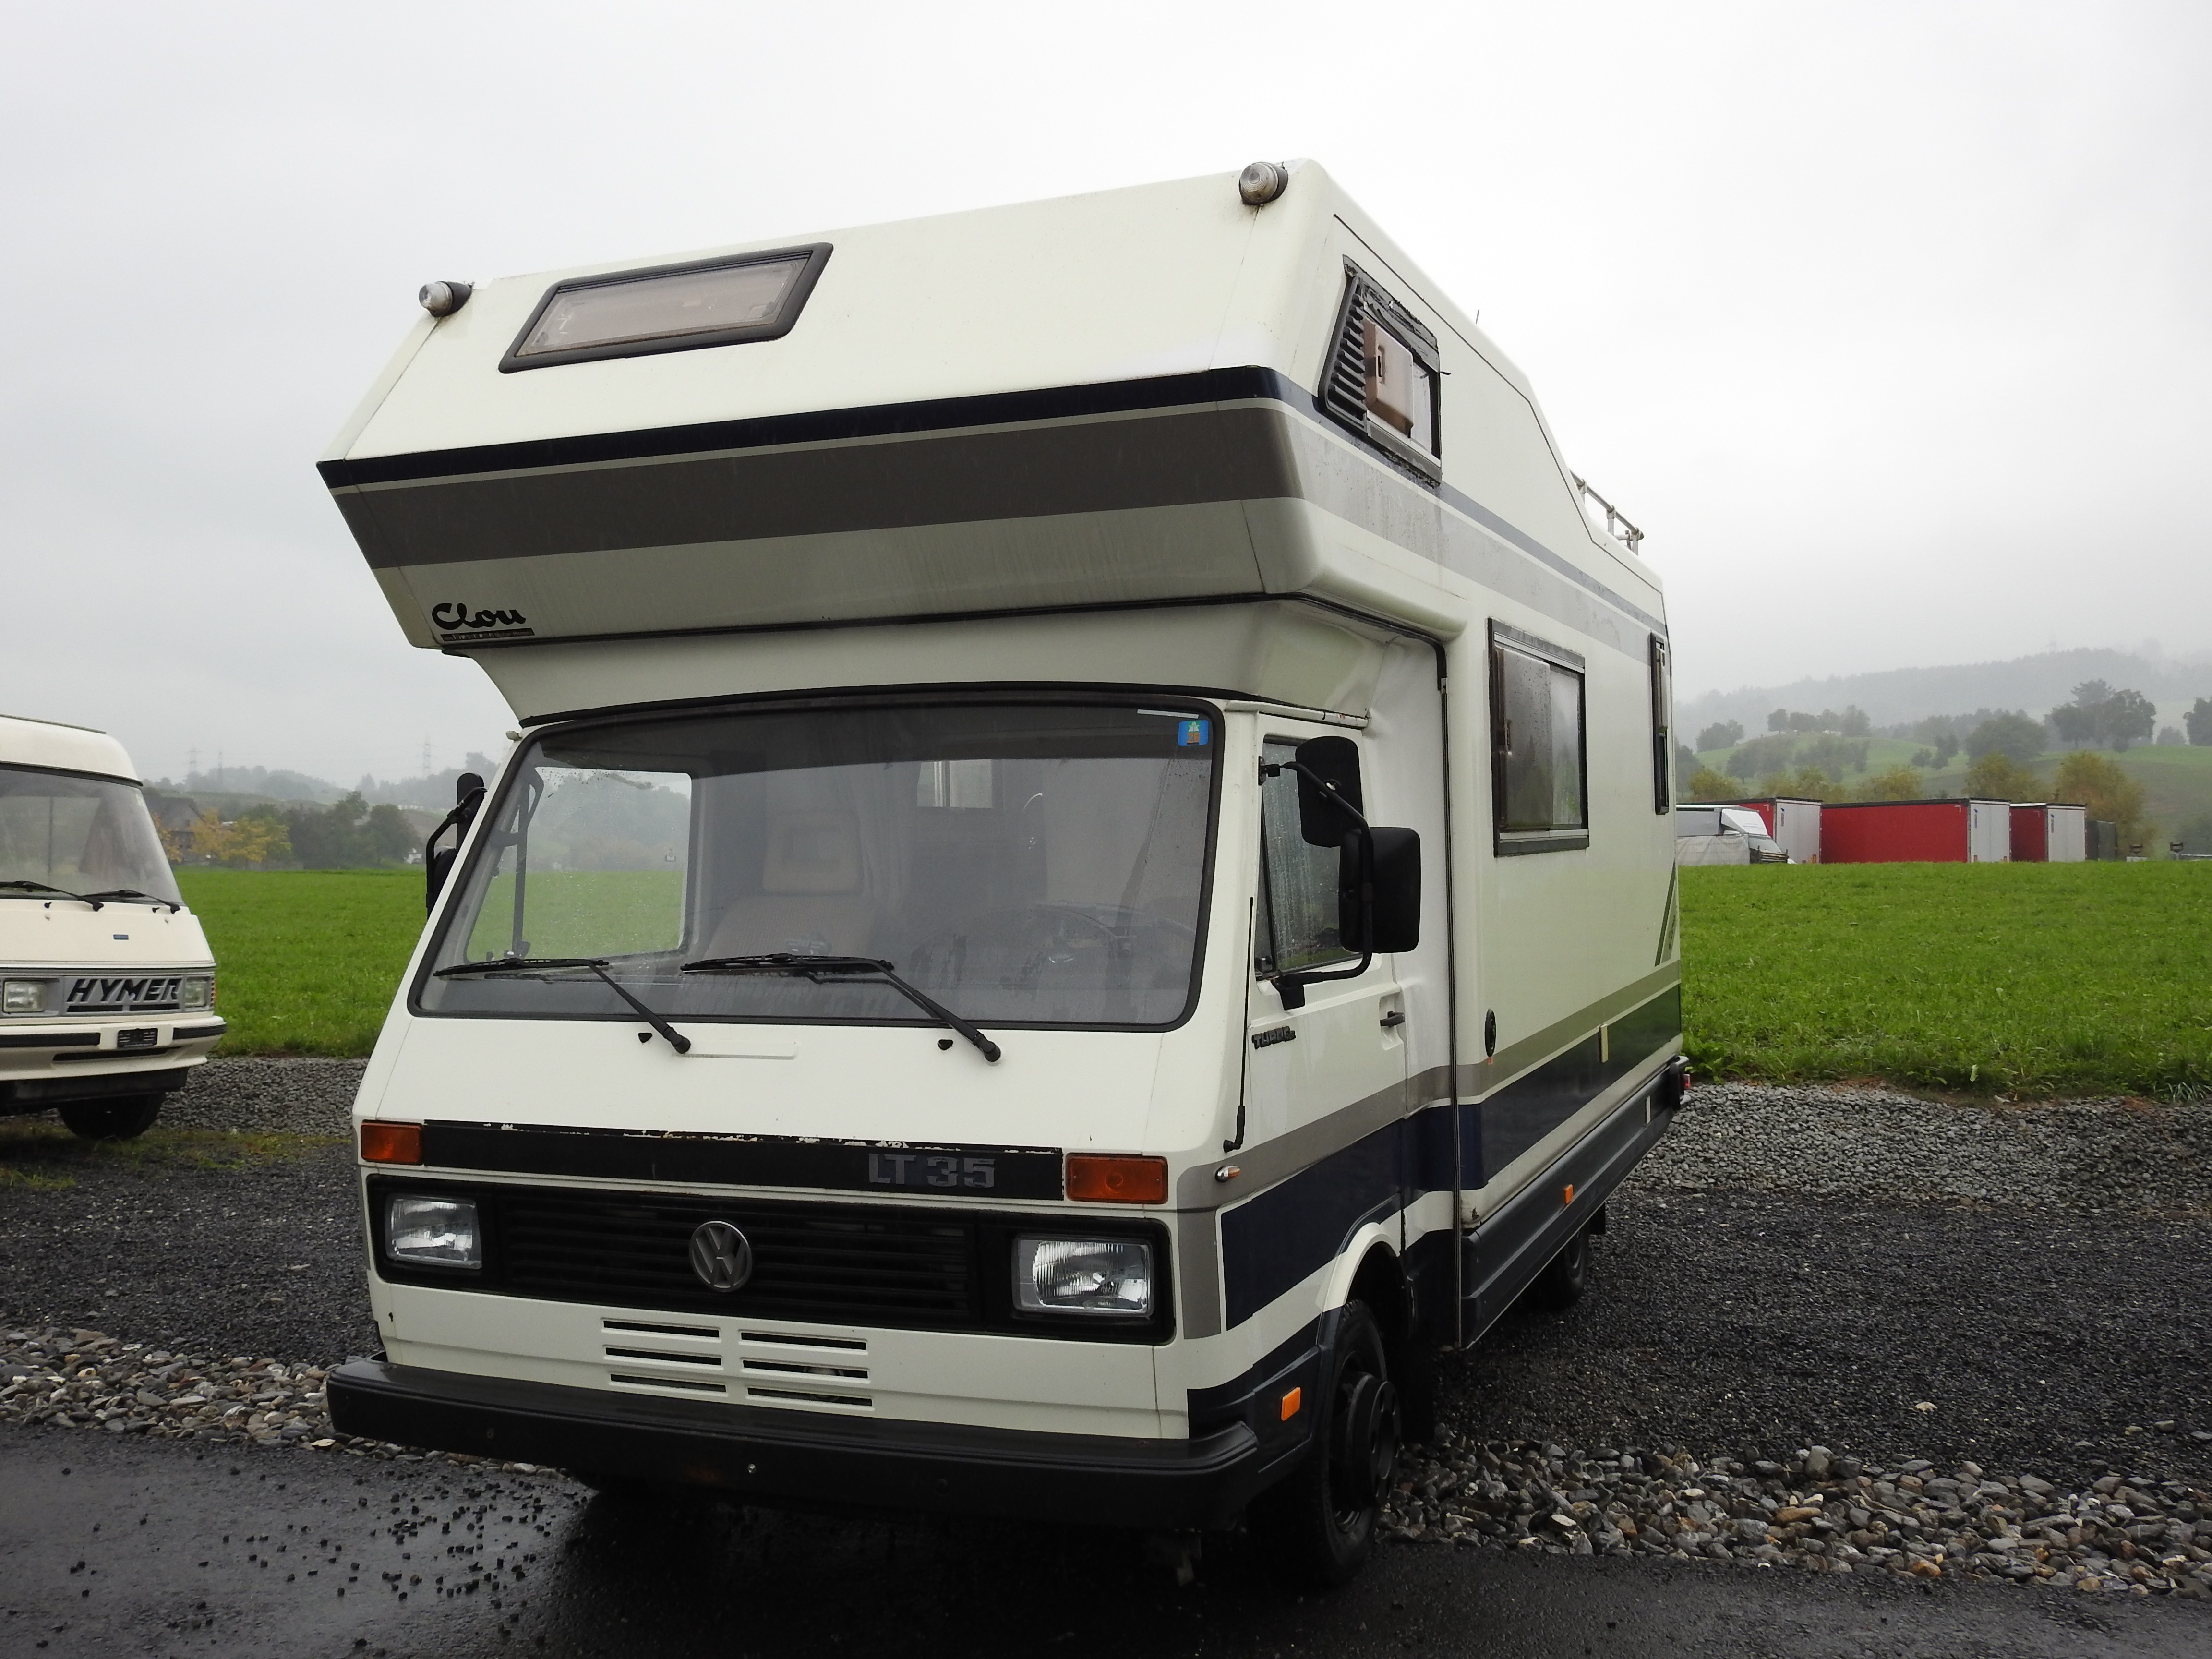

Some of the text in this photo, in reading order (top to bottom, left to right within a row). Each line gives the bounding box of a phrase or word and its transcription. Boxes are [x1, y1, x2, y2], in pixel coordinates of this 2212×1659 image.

[432, 602, 526, 630] Clou
[66, 978, 182, 1003] HYMER
[868, 1153, 996, 1189] LT 35
